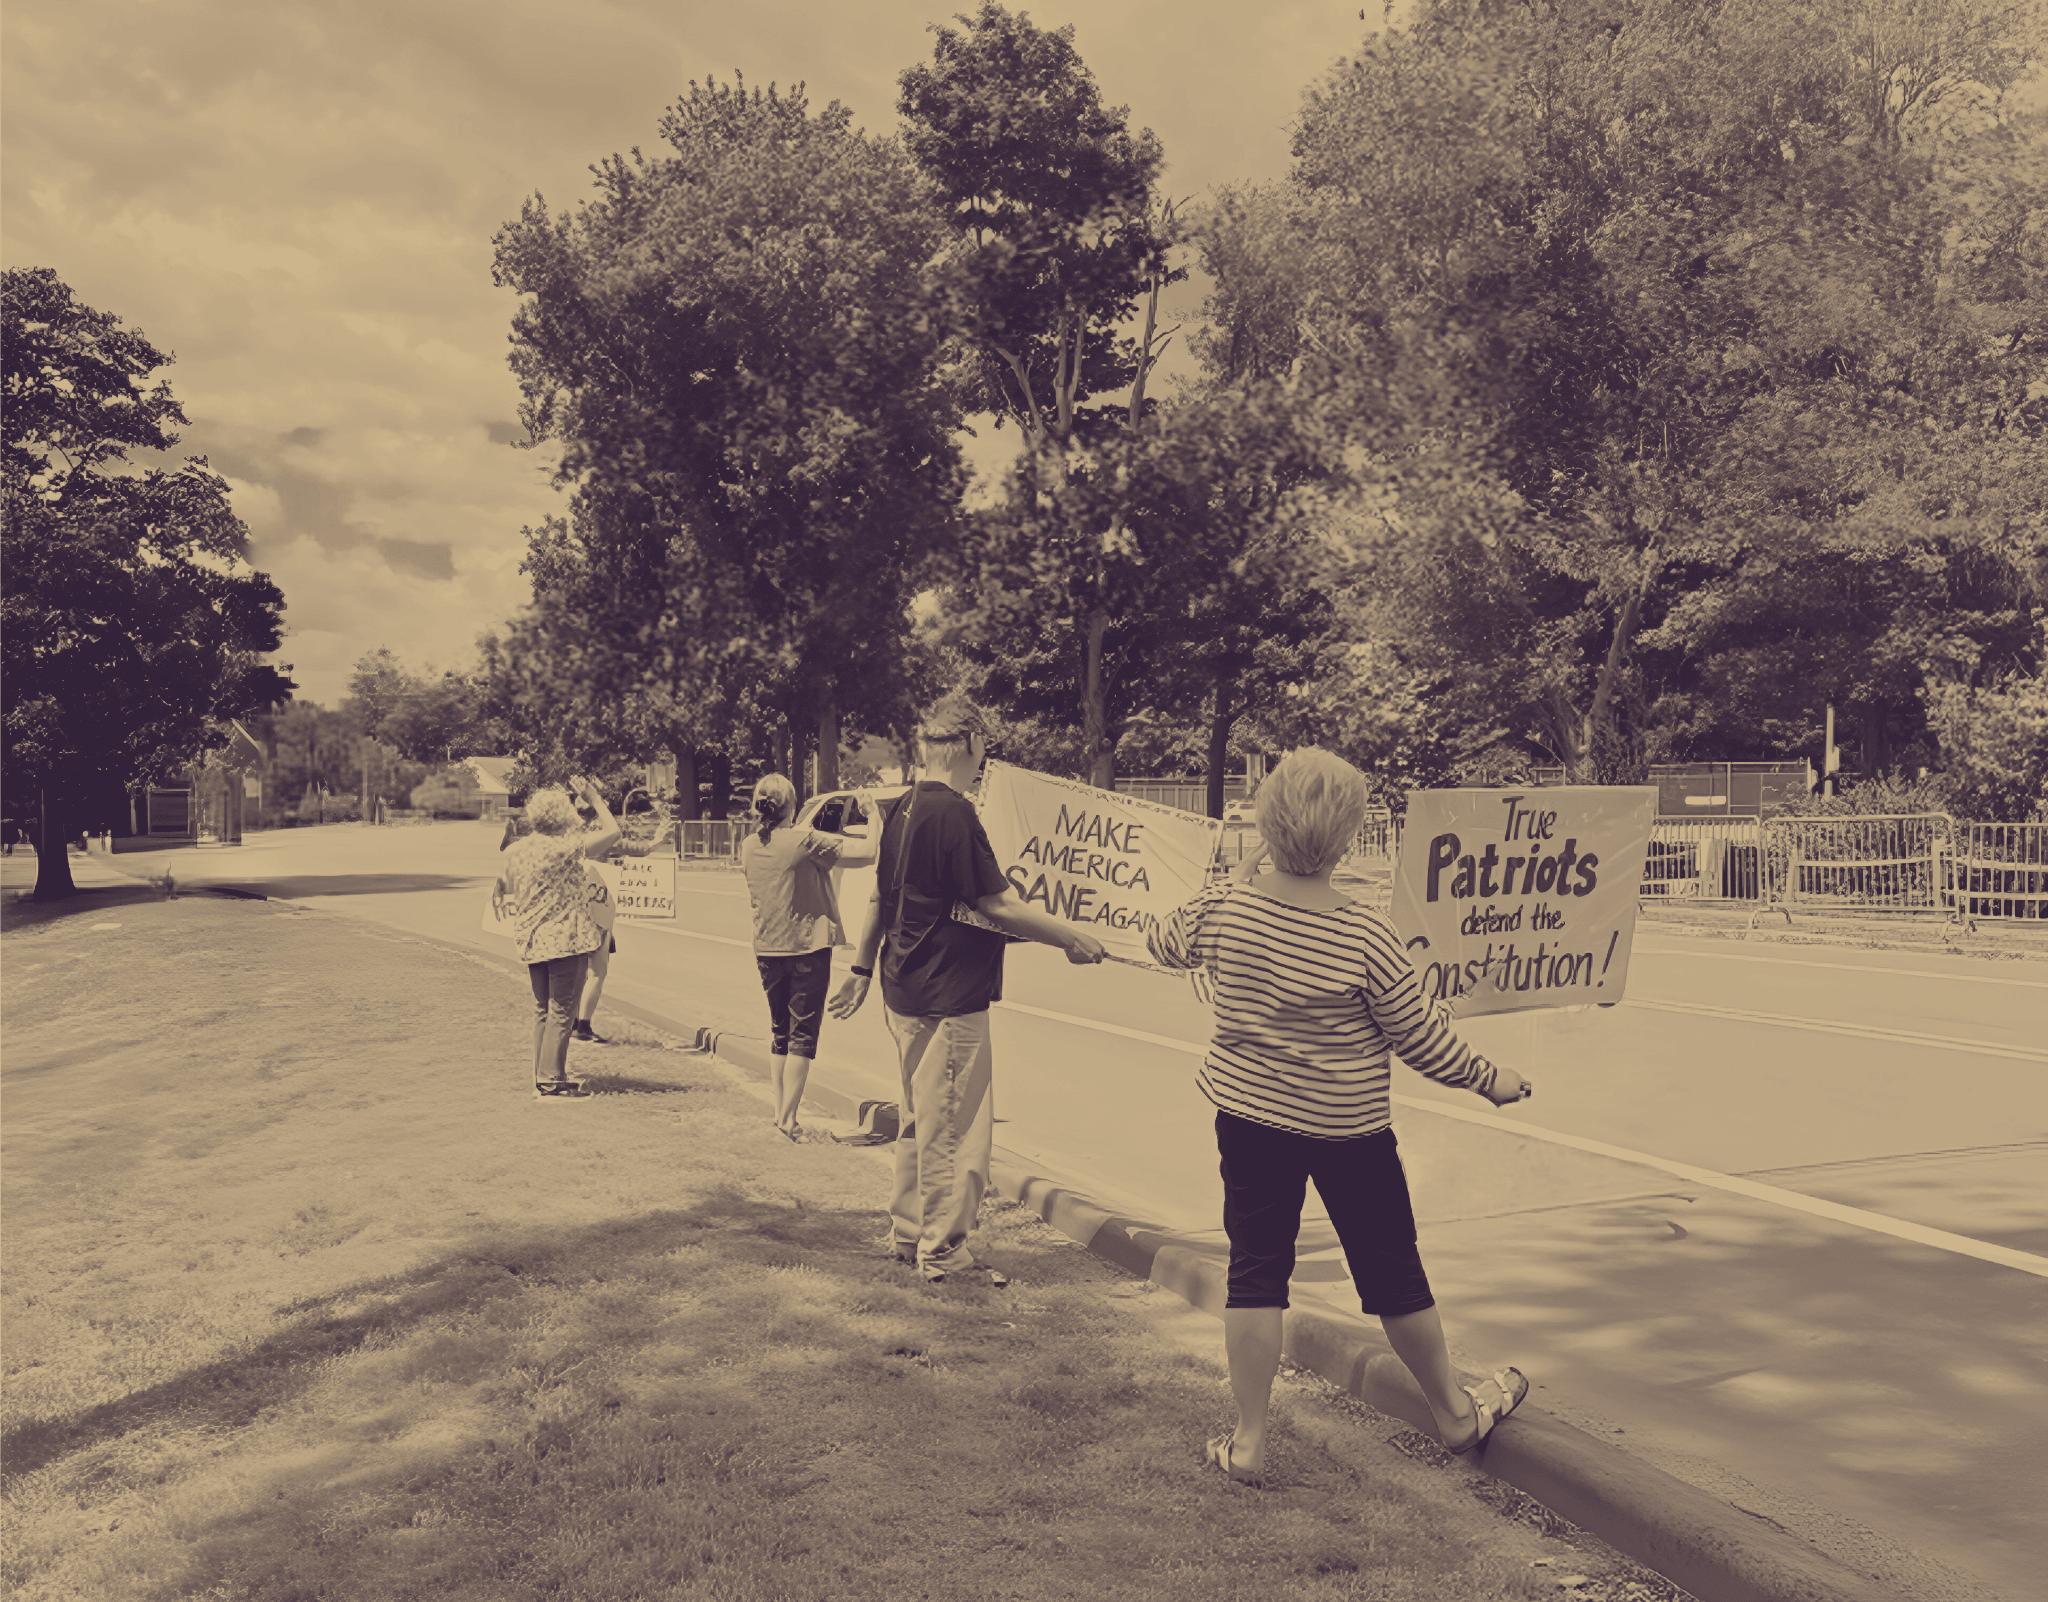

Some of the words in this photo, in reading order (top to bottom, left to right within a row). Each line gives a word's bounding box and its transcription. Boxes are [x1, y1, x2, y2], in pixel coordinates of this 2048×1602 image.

[1055, 803, 1144, 854] MAKE
[1502, 796, 1557, 842] True
[1019, 835, 1150, 891] AMERICA
[1426, 833, 1599, 903] Patriots
[1005, 865, 1098, 922] SANE
[1093, 901, 1151, 934] AGAI
[1461, 904, 1523, 936] defend
[1531, 902, 1565, 932] the
